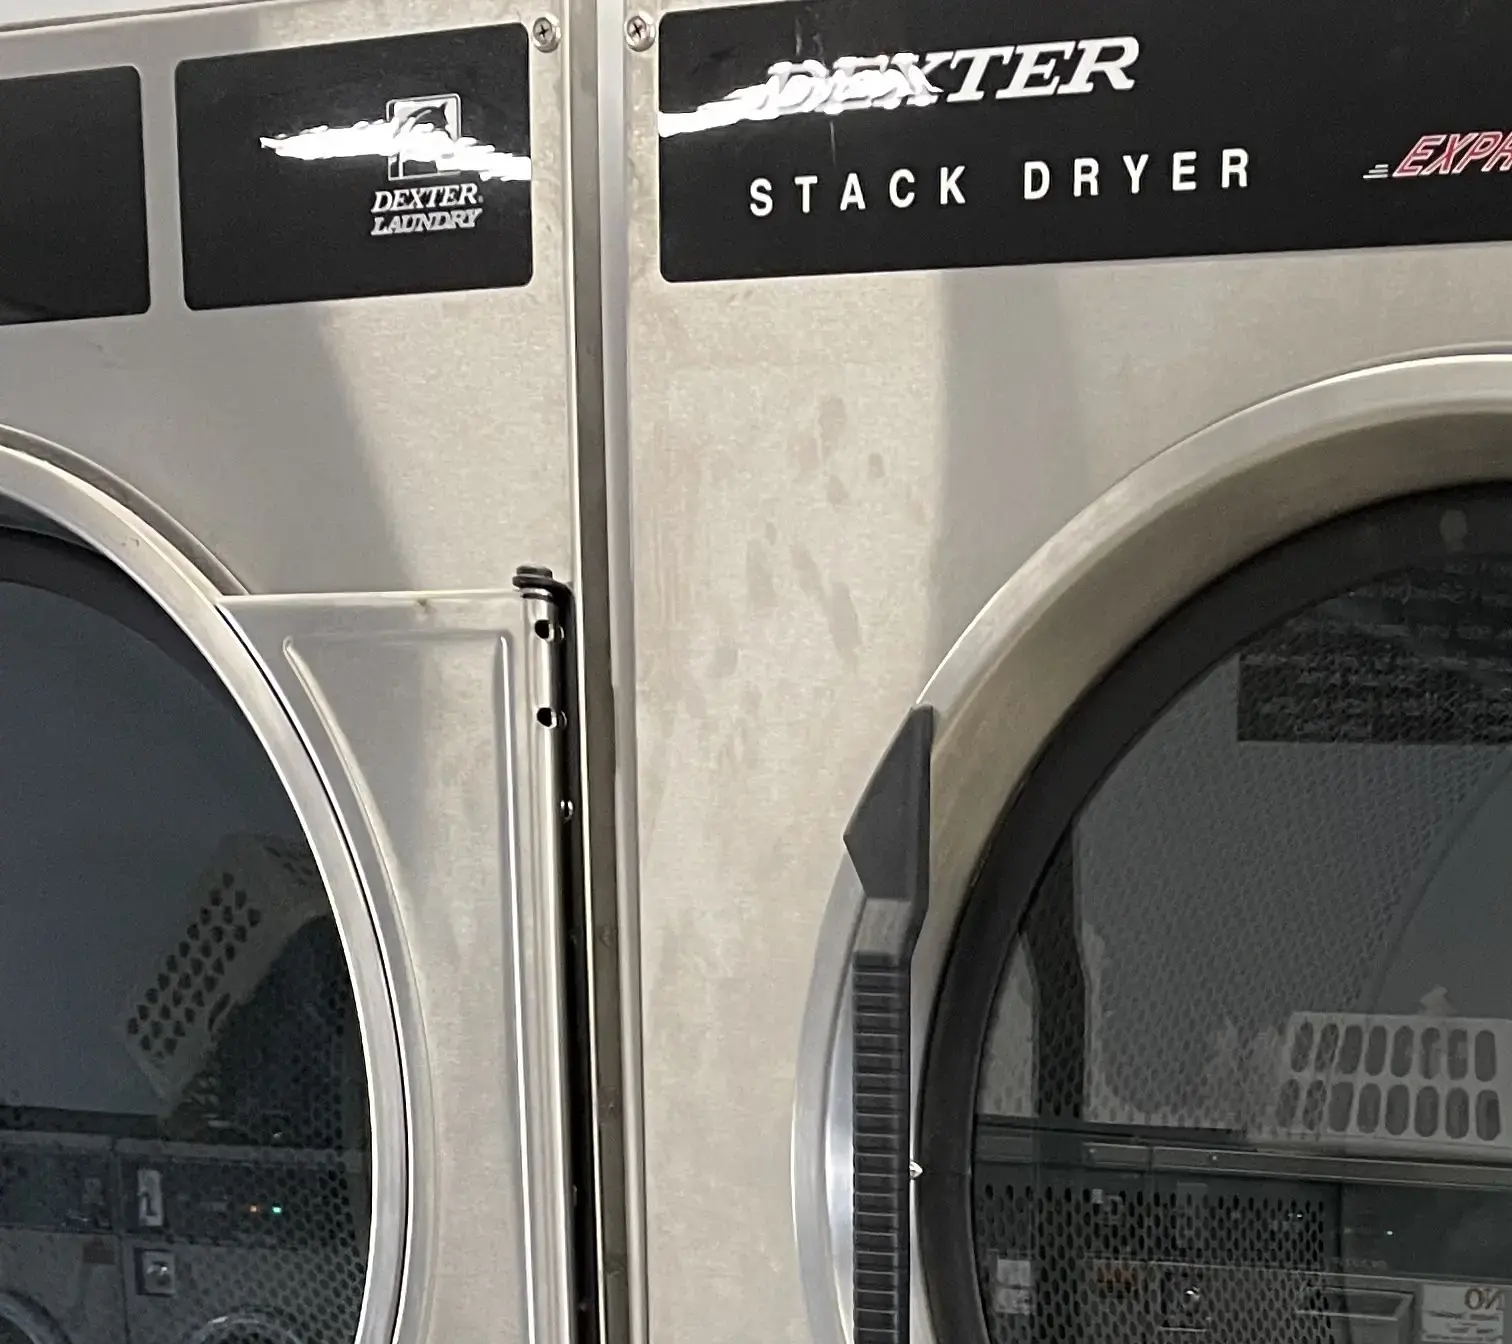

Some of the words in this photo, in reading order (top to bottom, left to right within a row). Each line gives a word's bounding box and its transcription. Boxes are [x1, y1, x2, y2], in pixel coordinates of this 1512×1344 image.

[767, 36, 1140, 114] DEXTER
[371, 183, 478, 214] DEXTER
[749, 166, 966, 218] STACK
[1023, 148, 1251, 200] DRYER
[370, 207, 482, 236] LAUNDRY
